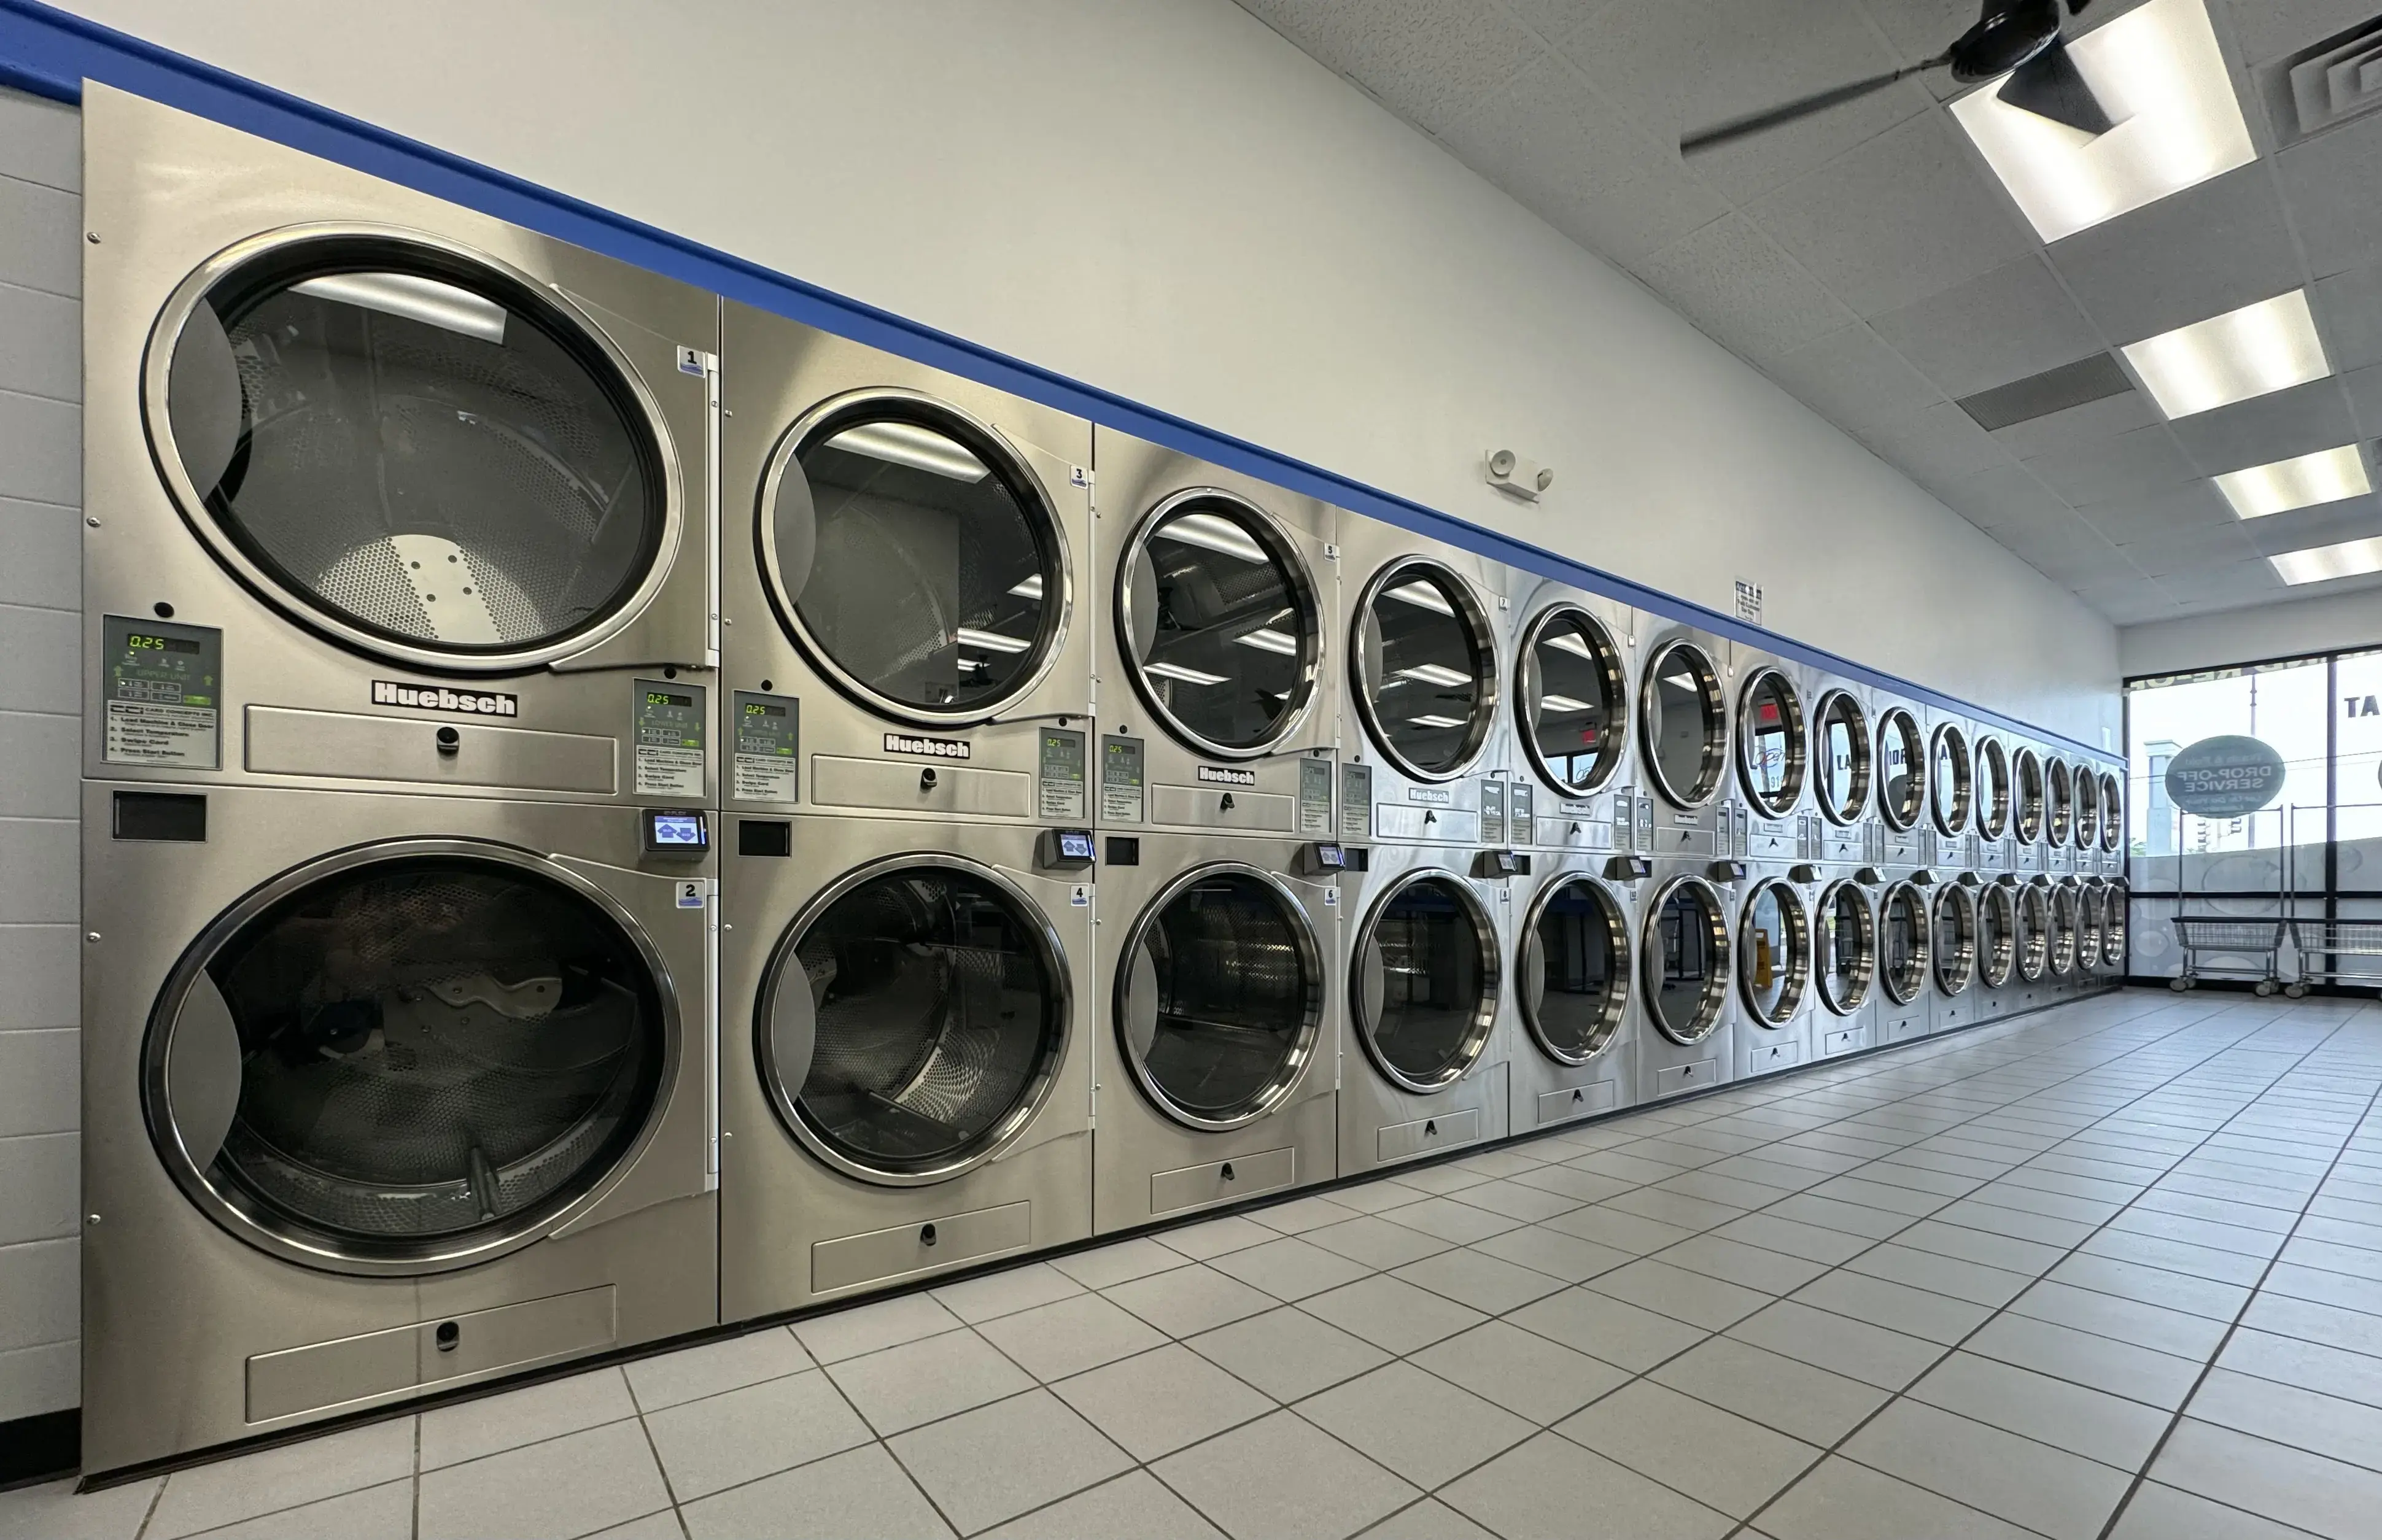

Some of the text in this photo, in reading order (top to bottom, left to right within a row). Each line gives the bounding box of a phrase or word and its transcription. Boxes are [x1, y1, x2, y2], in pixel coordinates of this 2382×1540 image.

[688, 350, 697, 365] 1
[1076, 468, 1082, 479] 3
[1328, 545, 1333, 554] 5
[130, 636, 165, 650] 0.25
[374, 683, 516, 715] Huebsch
[648, 694, 669, 705] 0.25
[746, 705, 766, 715] 0.25
[886, 735, 969, 757] Huebsch
[1199, 767, 1254, 784] Huebsch
[686, 884, 696, 897] 2
[1077, 888, 1083, 897] 4
